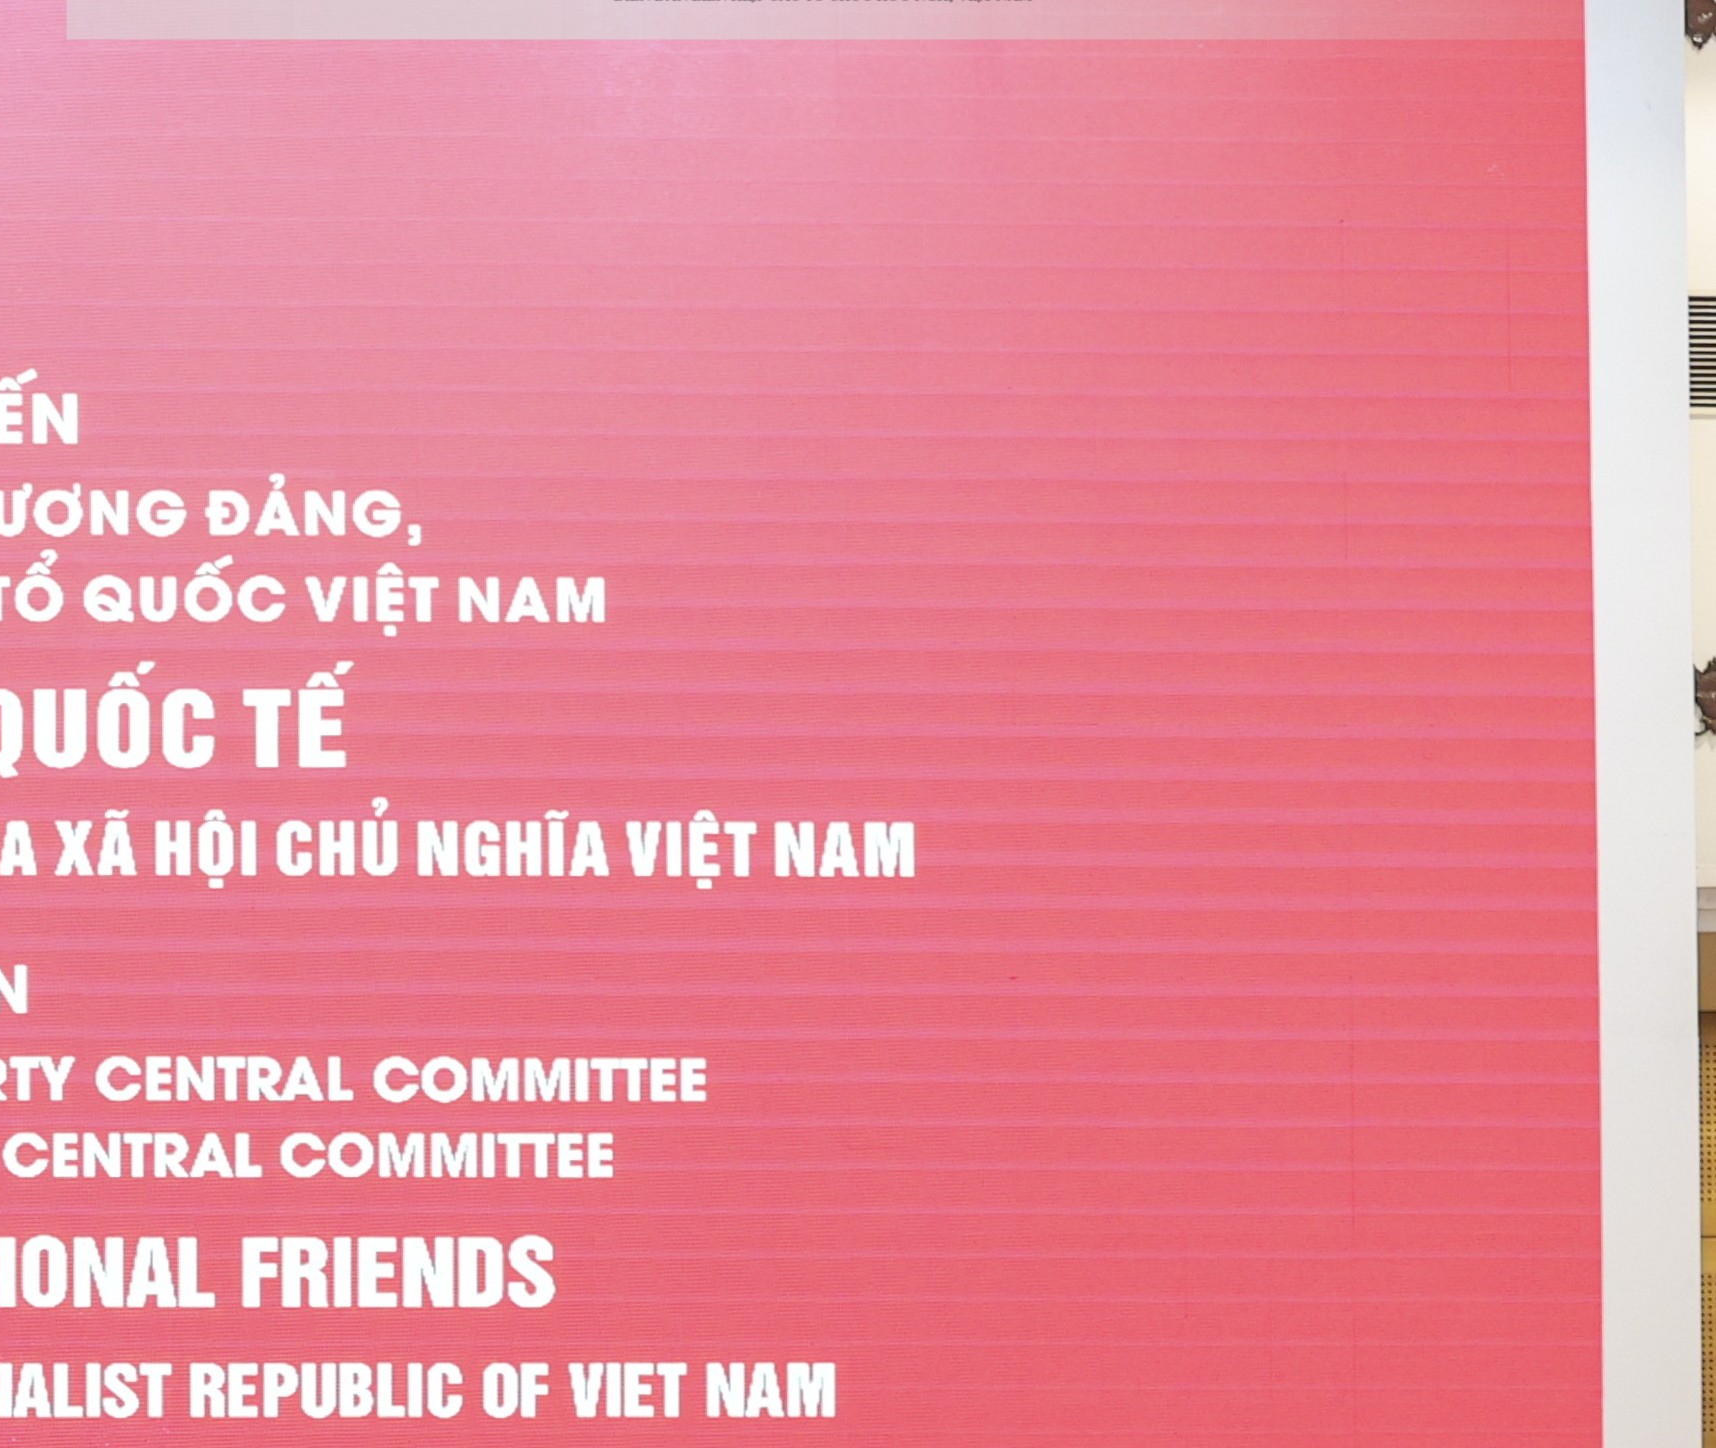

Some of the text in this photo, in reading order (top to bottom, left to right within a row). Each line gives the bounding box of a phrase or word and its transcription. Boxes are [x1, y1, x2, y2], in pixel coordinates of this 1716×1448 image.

[204, 472, 422, 547] ĐẢNG,
[83, 550, 286, 623] QUỐC
[305, 562, 440, 637] VIỆT
[458, 576, 606, 623] NAM
[242, 660, 354, 768] TẾ
[54, 809, 137, 876] XÃ
[155, 809, 257, 889] HỘI
[276, 796, 399, 877] CHỦ
[417, 809, 610, 877] NGHĨA
[626, 809, 757, 890] VIỆT
[774, 821, 915, 878] NAM
[95, 1055, 354, 1102] CENTRAL
[373, 1056, 707, 1103] COMMITTEE
[2, 1132, 263, 1178] CENTRAL
[280, 1132, 614, 1178] COMMITTEE
[242, 1235, 556, 1308] FRIENDS
[189, 1362, 463, 1419] REPUBLIC
[483, 1362, 549, 1419] OF
[568, 1362, 688, 1418] VIET
[706, 1362, 836, 1418] NAM
